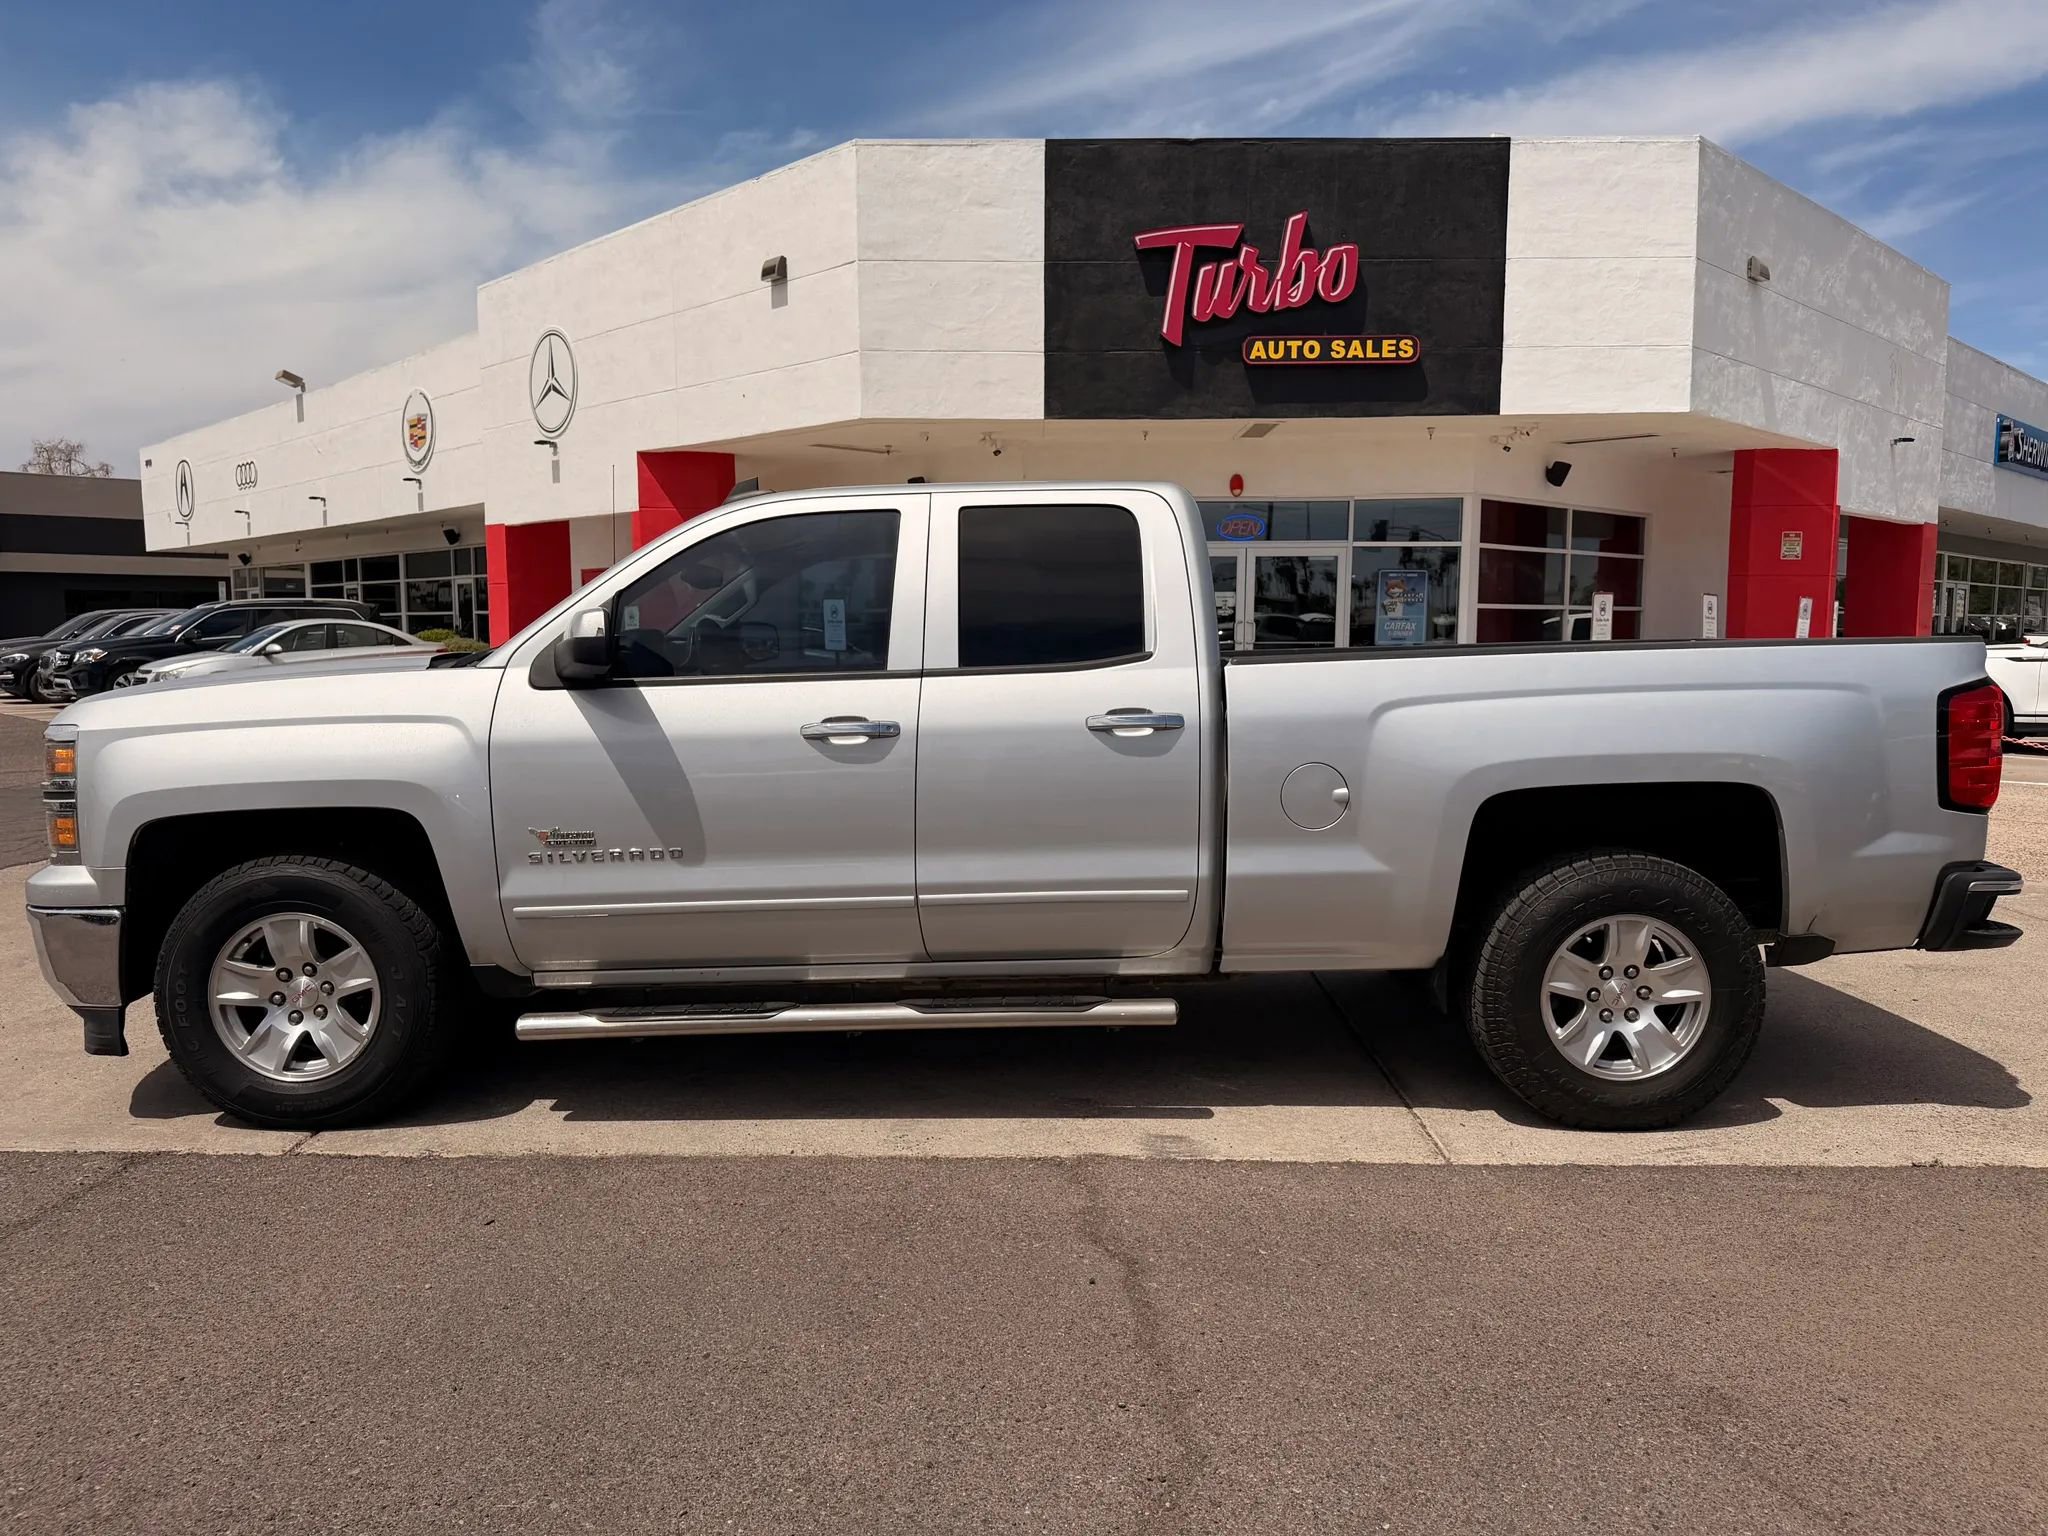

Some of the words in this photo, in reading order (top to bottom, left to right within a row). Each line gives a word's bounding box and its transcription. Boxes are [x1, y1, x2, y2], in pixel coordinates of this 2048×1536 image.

[1133, 209, 1359, 347] Turbo
[1250, 341, 1321, 360] AUTO
[1330, 339, 1414, 359] SALES
[2014, 428, 2048, 468] SHERWI
[1220, 519, 1259, 536] OPEN
[1384, 622, 1417, 631] CARFAX
[528, 847, 684, 865] SILVERADO
[291, 984, 313, 1003] GMC
[1611, 982, 1628, 1006] GMC
